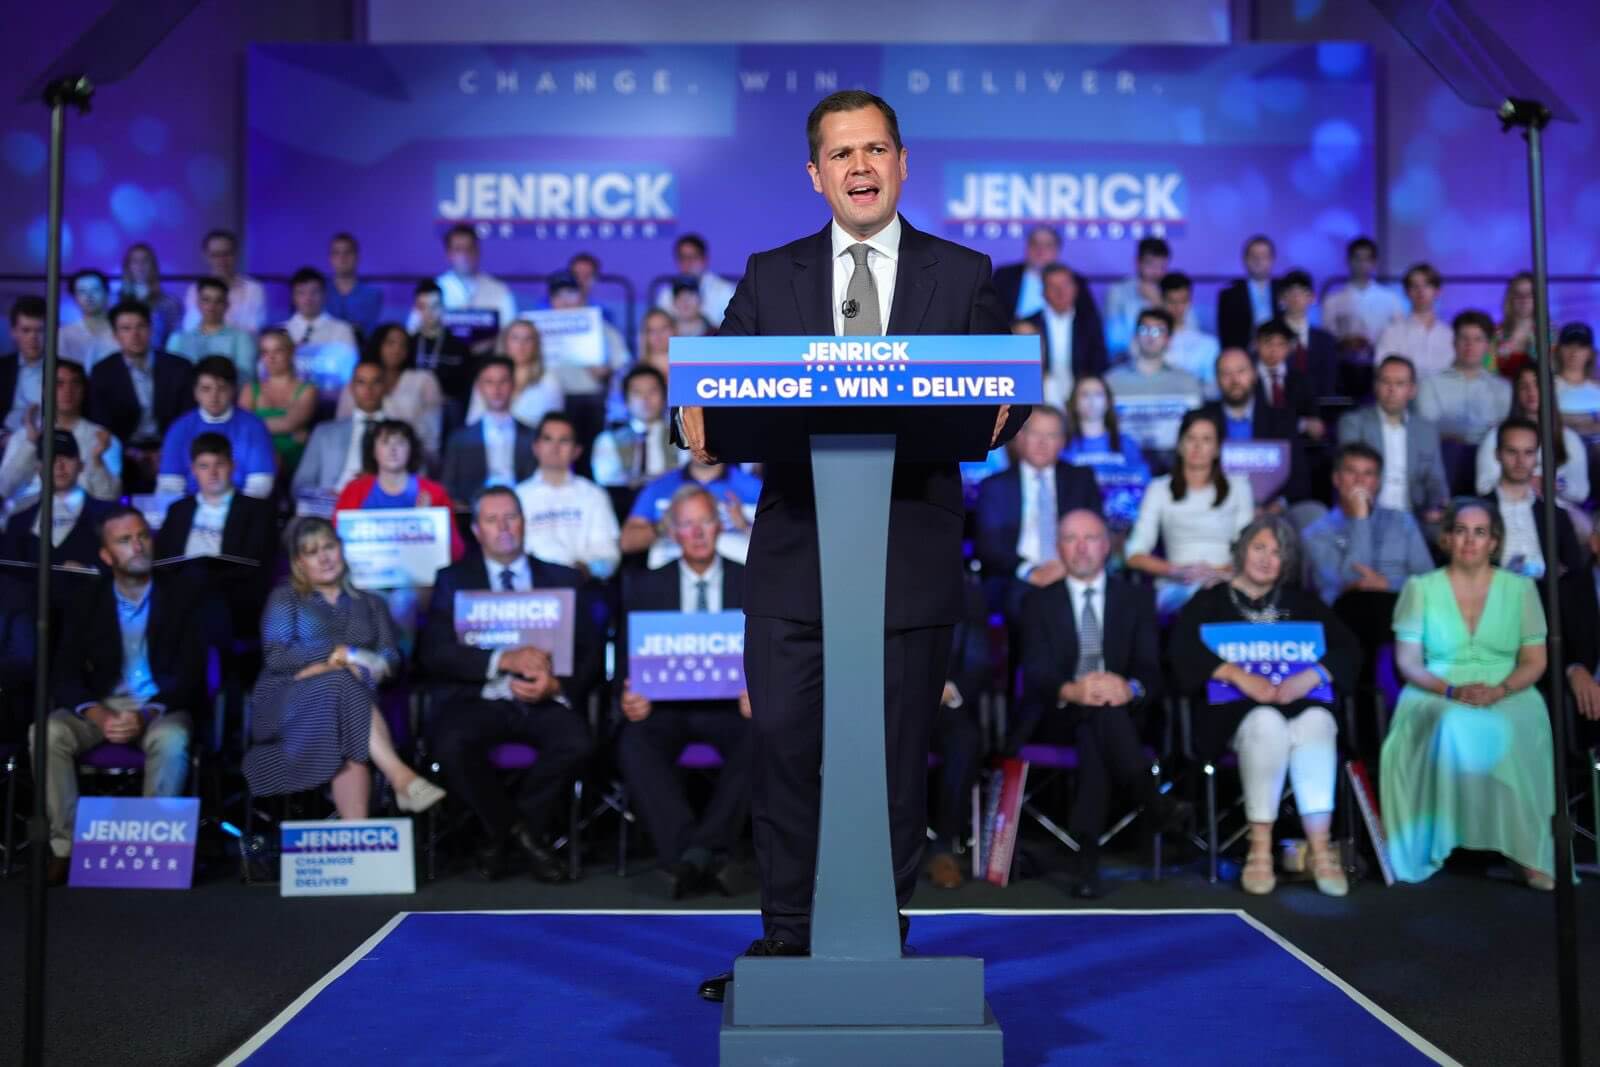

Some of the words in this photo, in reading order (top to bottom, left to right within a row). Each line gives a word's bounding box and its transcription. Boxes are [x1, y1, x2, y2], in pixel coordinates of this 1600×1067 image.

[459, 70, 698, 93] CHANGE.
[908, 70, 1163, 94] DELIVER.
[438, 173, 674, 219] JENRICK
[951, 173, 1182, 219] JENRICK
[963, 222, 1023, 239] FOR
[802, 341, 910, 361] JENRICK
[806, 364, 835, 372] FOR
[847, 364, 906, 372] LEADER
[696, 378, 813, 399] CHANGE
[835, 378, 888, 398] WIN
[912, 376, 1016, 398] DELIVER
[466, 601, 560, 622] JENRICK
[638, 633, 743, 656] JENRICK
[667, 656, 715, 669] FOR
[642, 668, 740, 683] LEADER
[82, 820, 187, 842] JENRICK
[295, 828, 398, 849] JENRICK
[109, 845, 155, 857] FOR
[83, 858, 179, 871] LEADER
[295, 878, 349, 887] DELIVER
